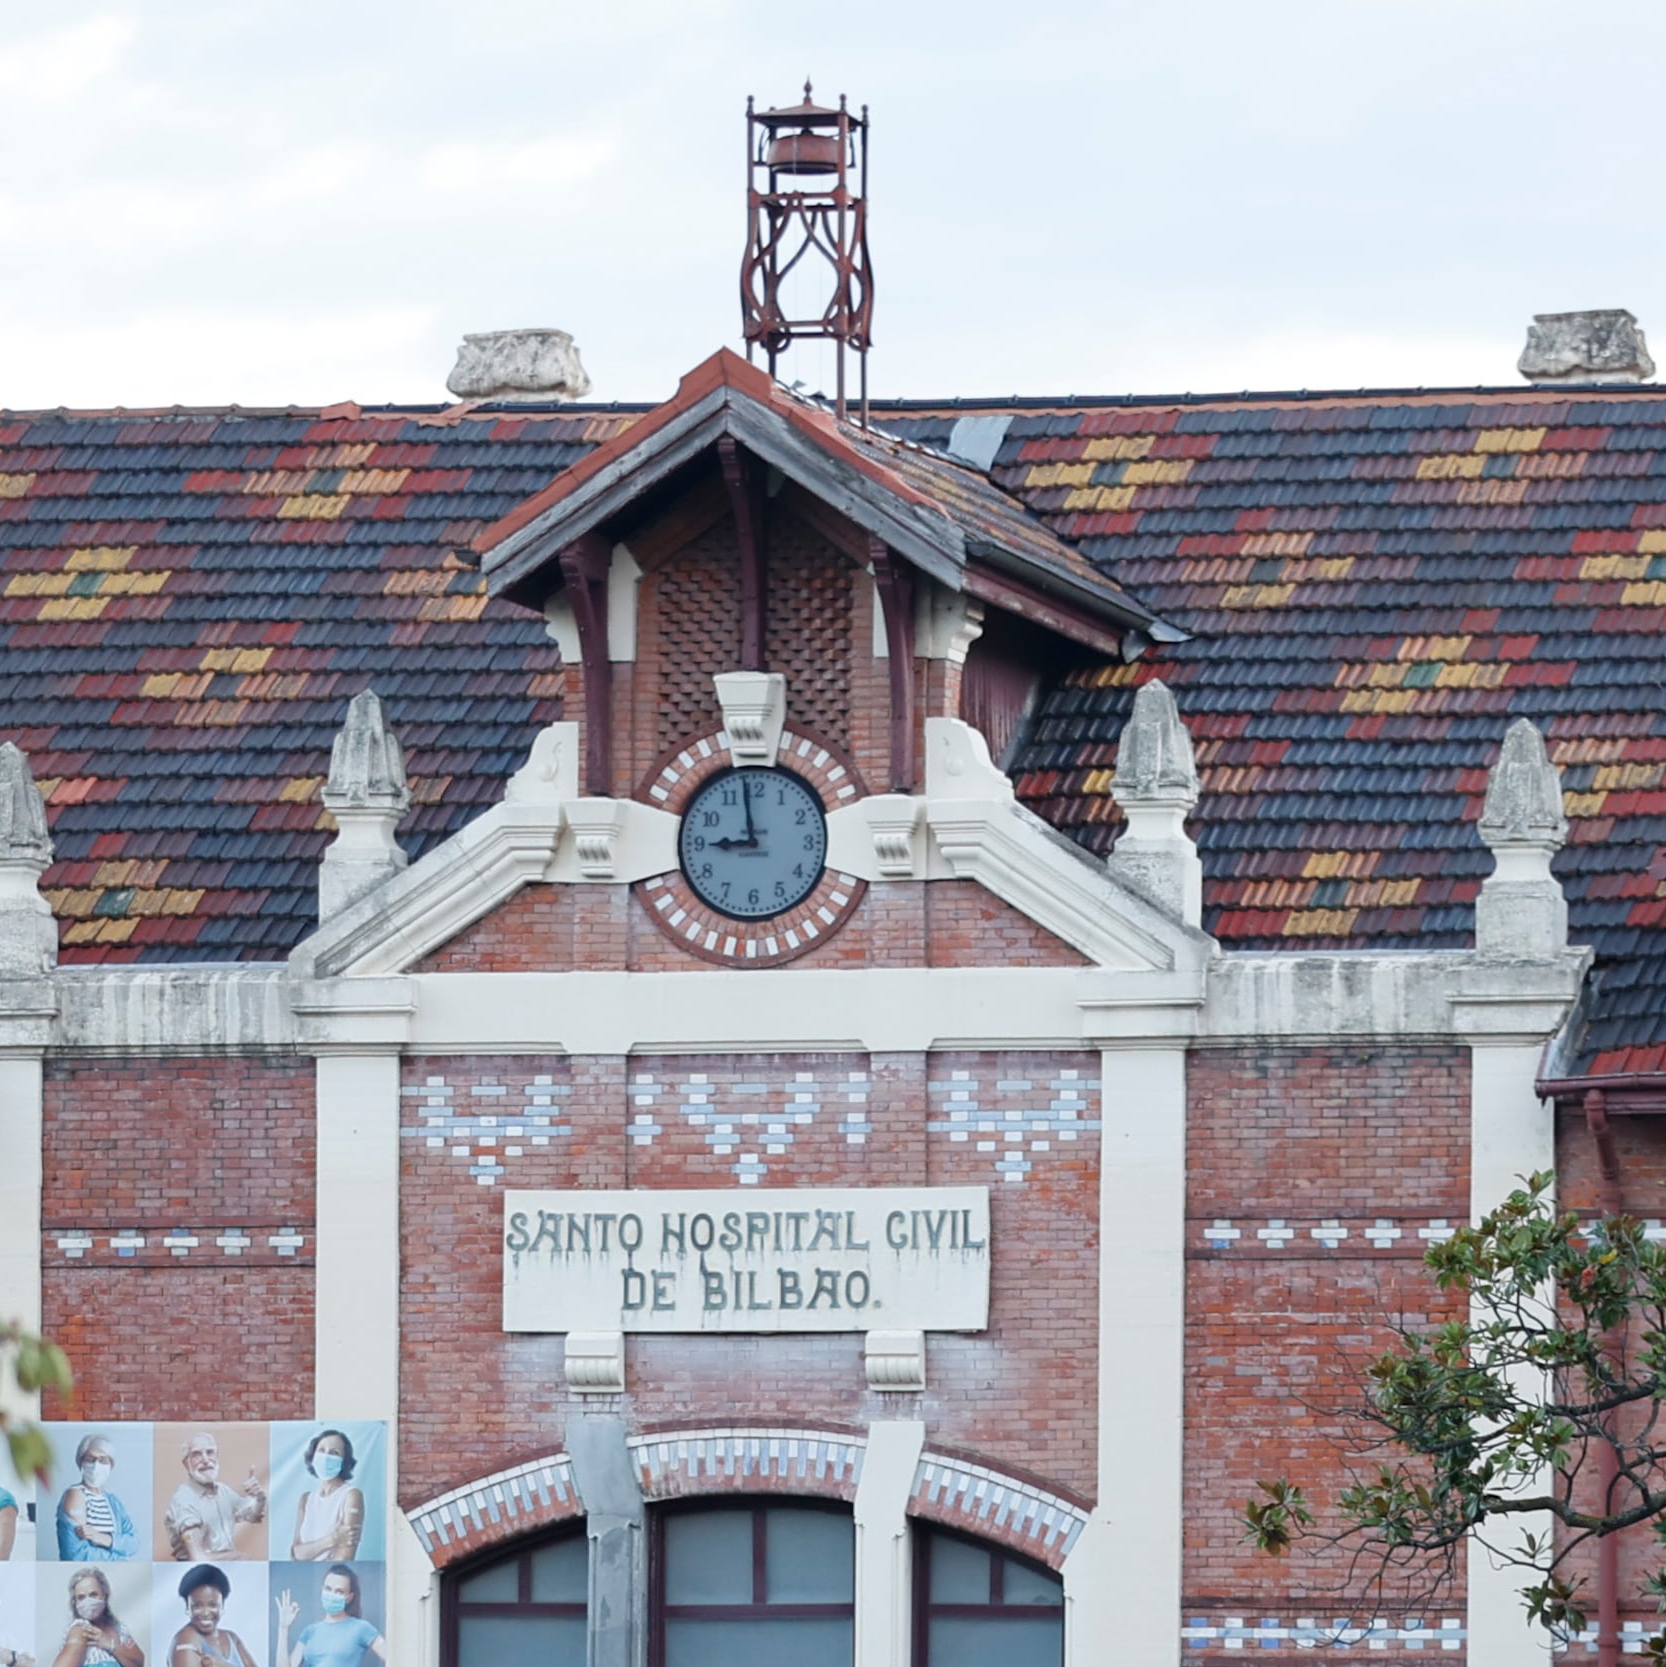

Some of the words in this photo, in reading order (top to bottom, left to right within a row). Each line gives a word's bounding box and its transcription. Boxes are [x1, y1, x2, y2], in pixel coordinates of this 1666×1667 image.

[721, 790, 737, 806] 11
[776, 790, 785, 806] 1
[703, 811, 720, 828] 10
[795, 809, 806, 825] 2
[694, 836, 705, 852] 9
[803, 835, 814, 851] 3
[702, 863, 713, 879] 8
[792, 863, 804, 879] 4
[721, 882, 731, 899] 7
[748, 889, 759, 905] 6
[774, 881, 785, 898] 5
[505, 1209, 643, 1253] SANTO
[661, 1208, 870, 1253] HOSPITAL
[885, 1208, 986, 1250] CIVIL
[620, 1267, 676, 1312] DE
[700, 1267, 883, 1311] BILBAO.
